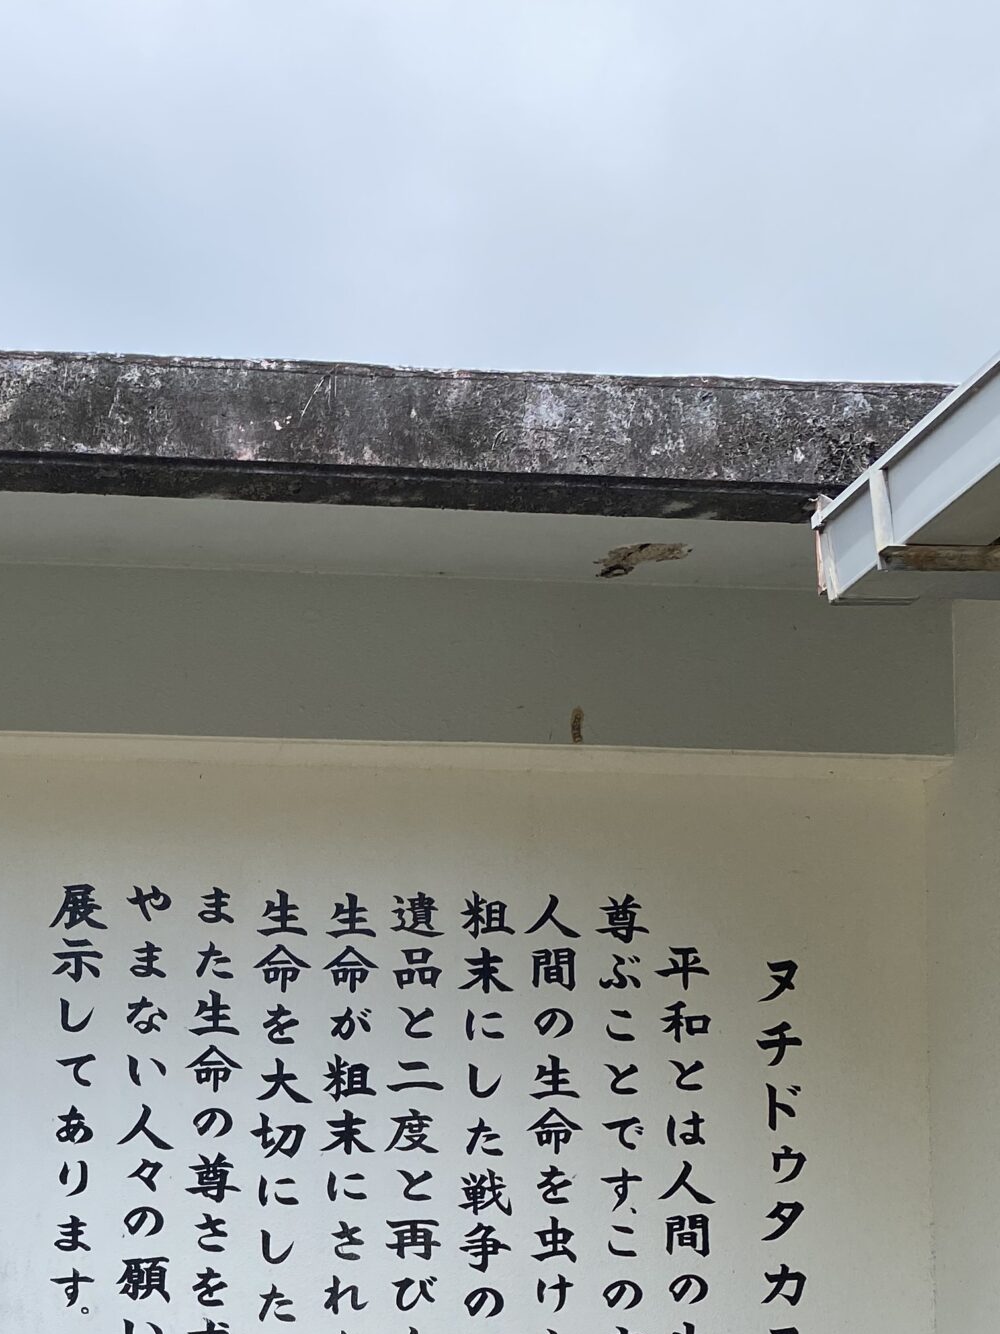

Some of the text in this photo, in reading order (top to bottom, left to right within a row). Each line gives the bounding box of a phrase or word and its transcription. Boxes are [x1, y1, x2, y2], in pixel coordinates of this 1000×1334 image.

[49, 884, 108, 1315] 展示してあります。
